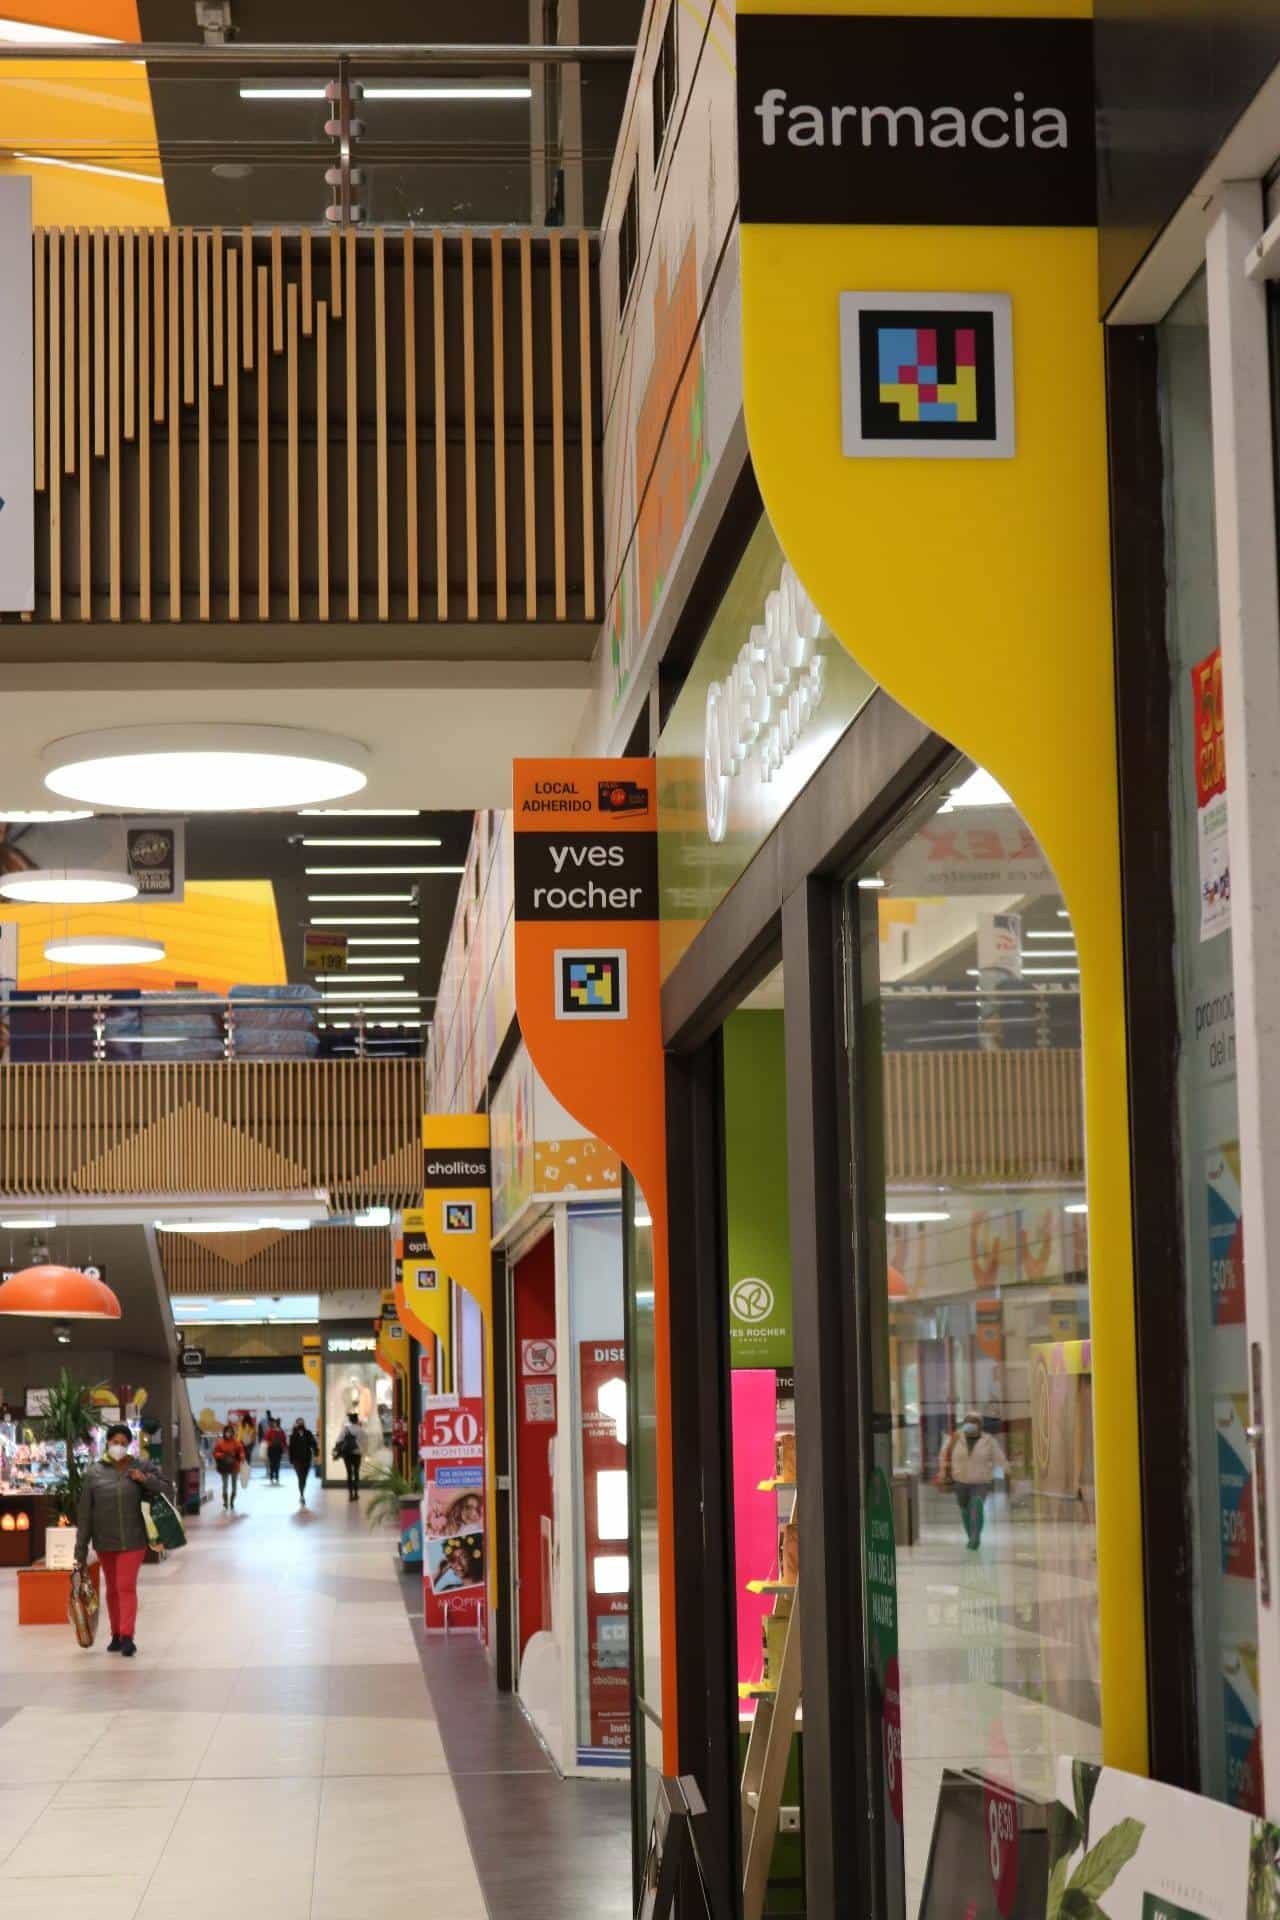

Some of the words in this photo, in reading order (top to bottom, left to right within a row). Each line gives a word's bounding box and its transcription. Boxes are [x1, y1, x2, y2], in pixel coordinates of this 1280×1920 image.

[754, 88, 1069, 149] farmacia
[535, 782, 579, 795] LOCAL
[522, 799, 592, 812] ADHERIDO
[548, 845, 625, 873] yves
[533, 880, 643, 909] rocher
[427, 1161, 487, 1175] chollitos
[746, 1328, 786, 1337] ROCHER
[431, 1412, 478, 1446] 50
